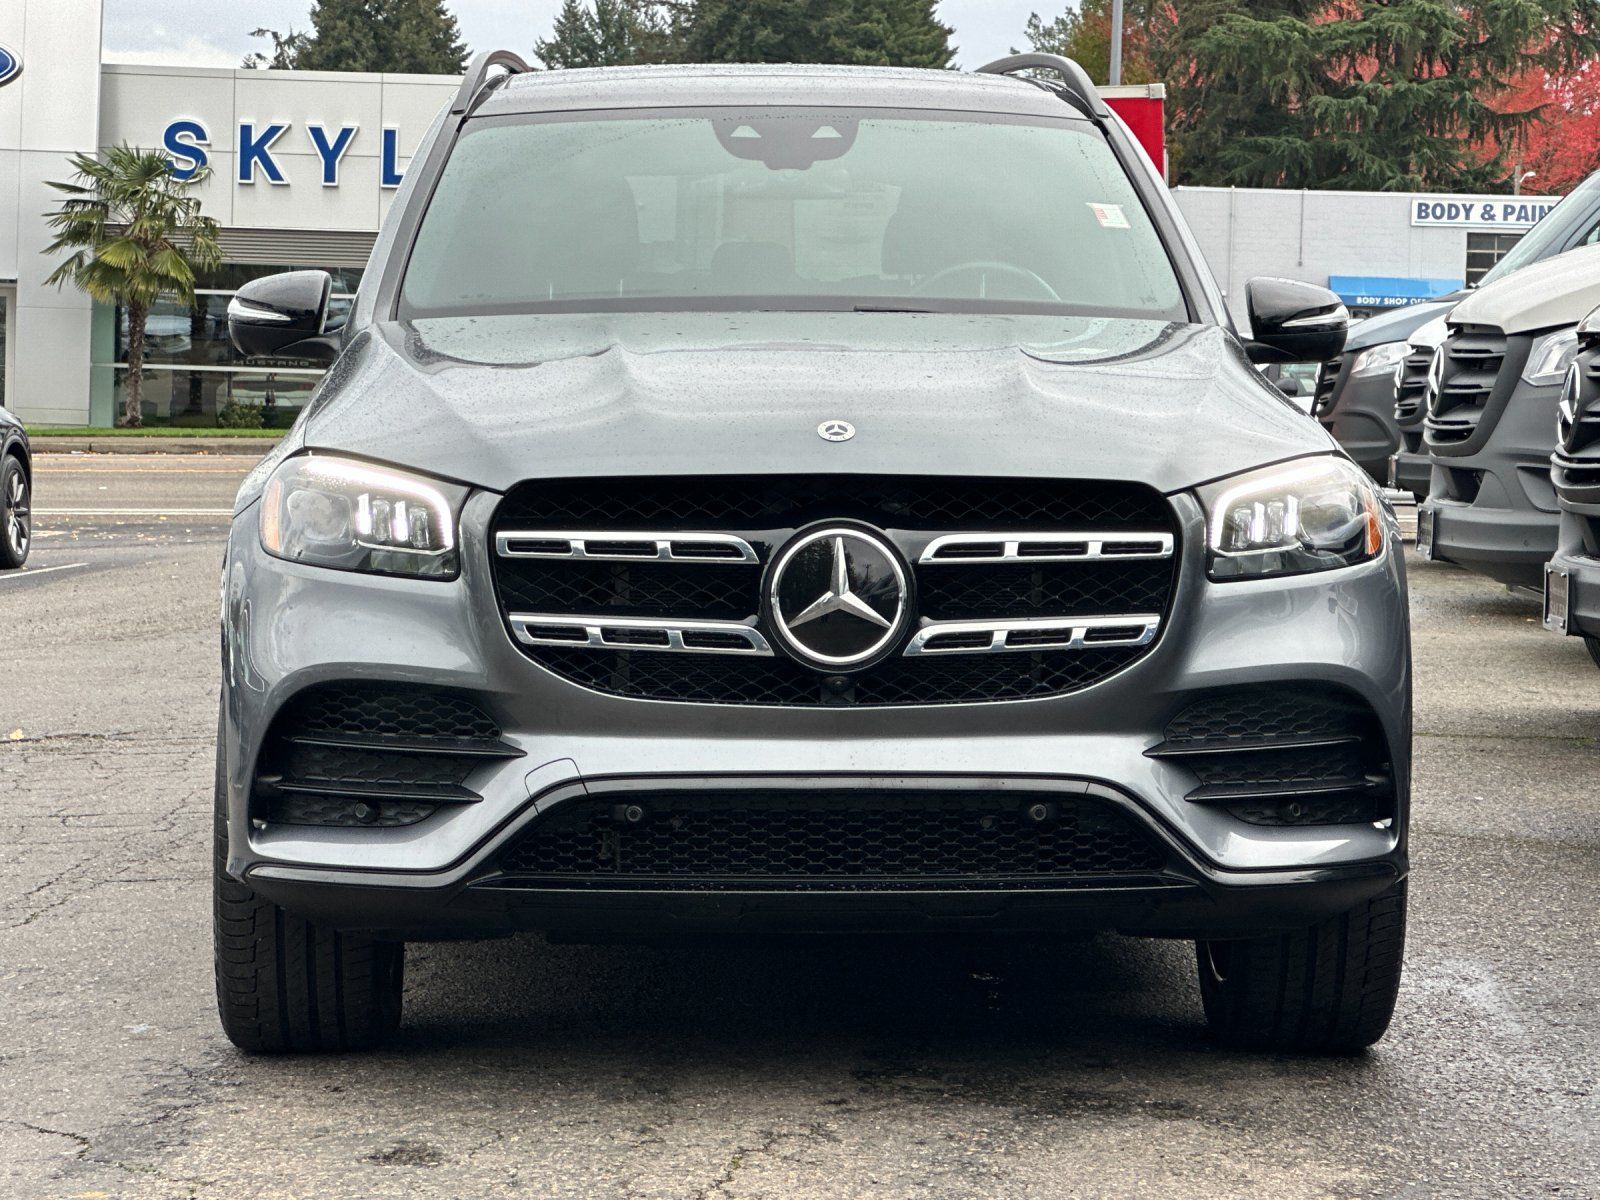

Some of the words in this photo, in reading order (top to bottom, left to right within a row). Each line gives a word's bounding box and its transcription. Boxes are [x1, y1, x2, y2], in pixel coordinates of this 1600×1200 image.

[162, 118, 406, 188] SKYL
[1417, 202, 1475, 220] BODY
[1480, 203, 1496, 221] &
[1356, 296, 1381, 304] BODY
[1384, 297, 1407, 305] SHOP
[233, 359, 310, 367] MUSTANG
